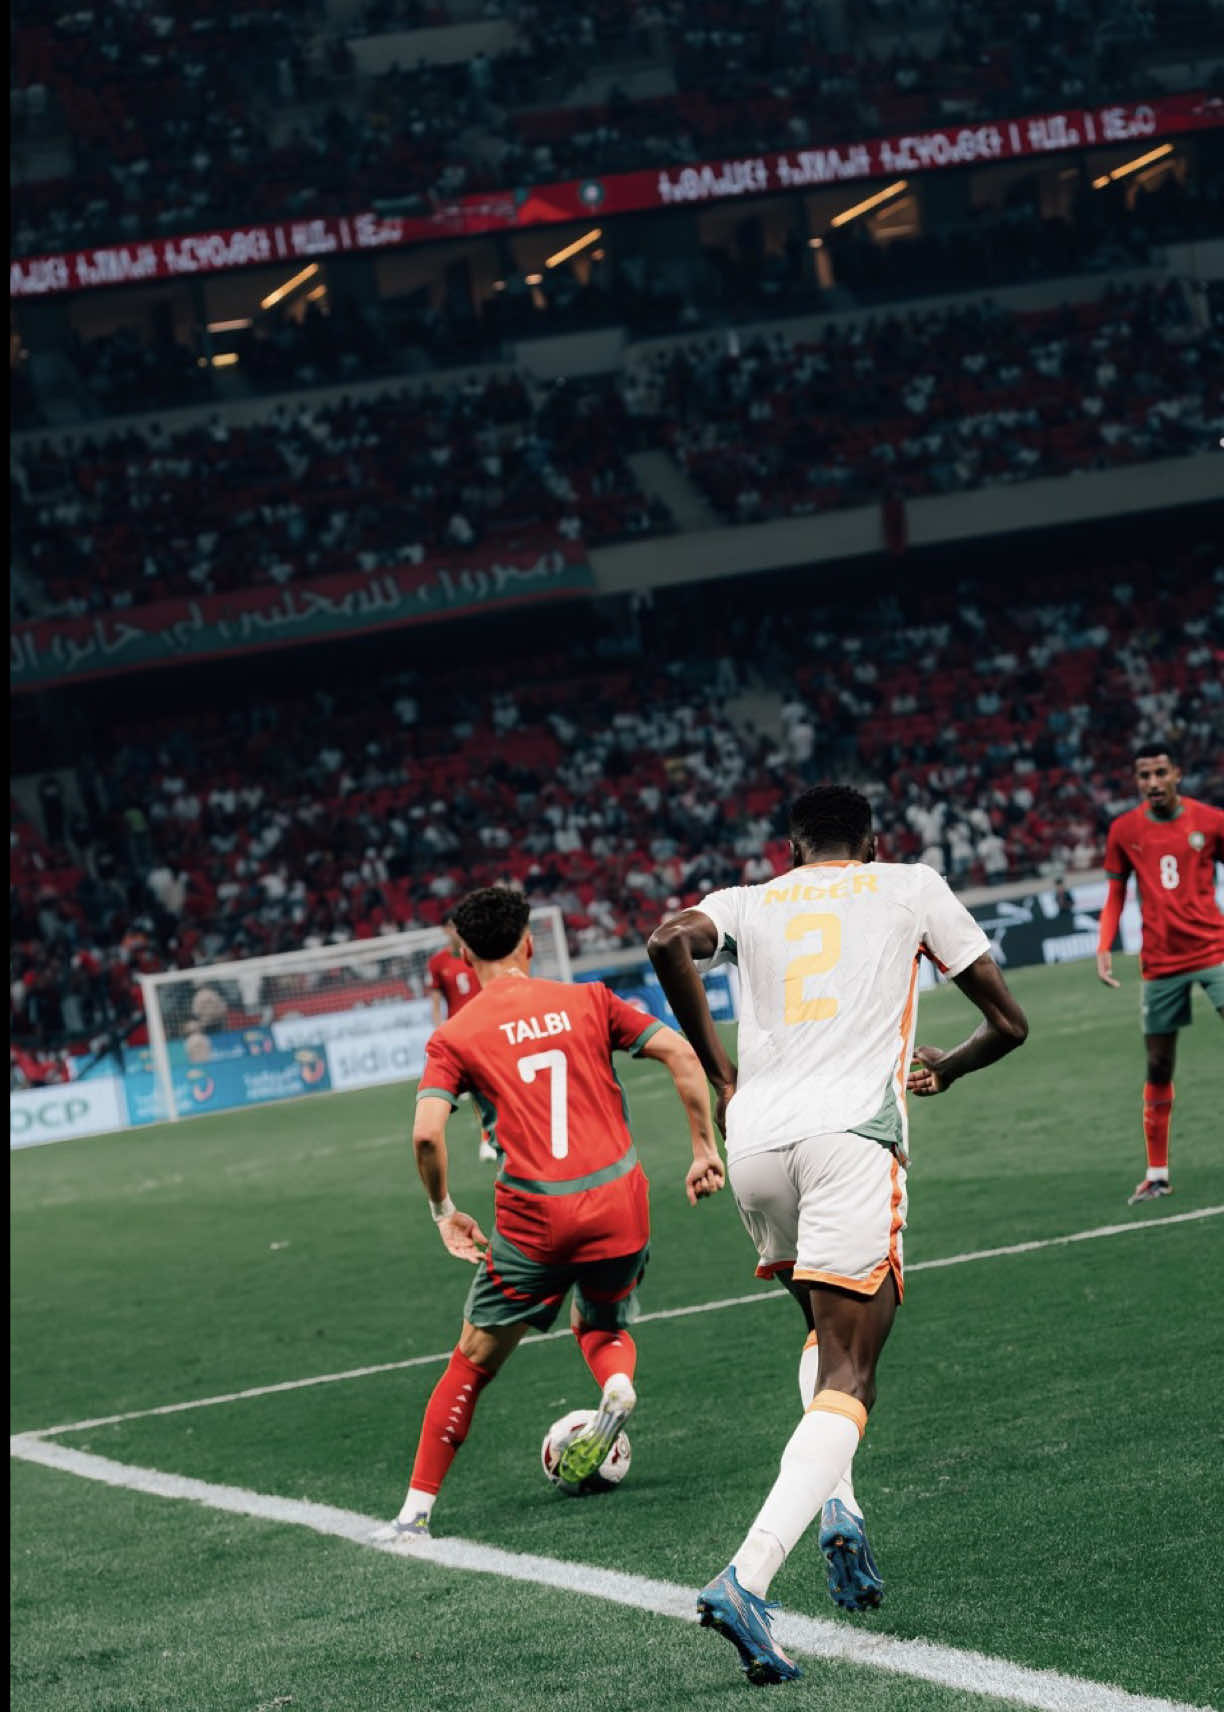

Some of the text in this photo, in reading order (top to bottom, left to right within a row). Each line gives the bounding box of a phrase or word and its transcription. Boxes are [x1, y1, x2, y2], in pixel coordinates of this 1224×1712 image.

[763, 873, 880, 905] NIGER
[1159, 854, 1180, 890] 8
[783, 911, 843, 1027] 2
[498, 1010, 573, 1046] TALBI
[516, 1048, 570, 1161] 7
